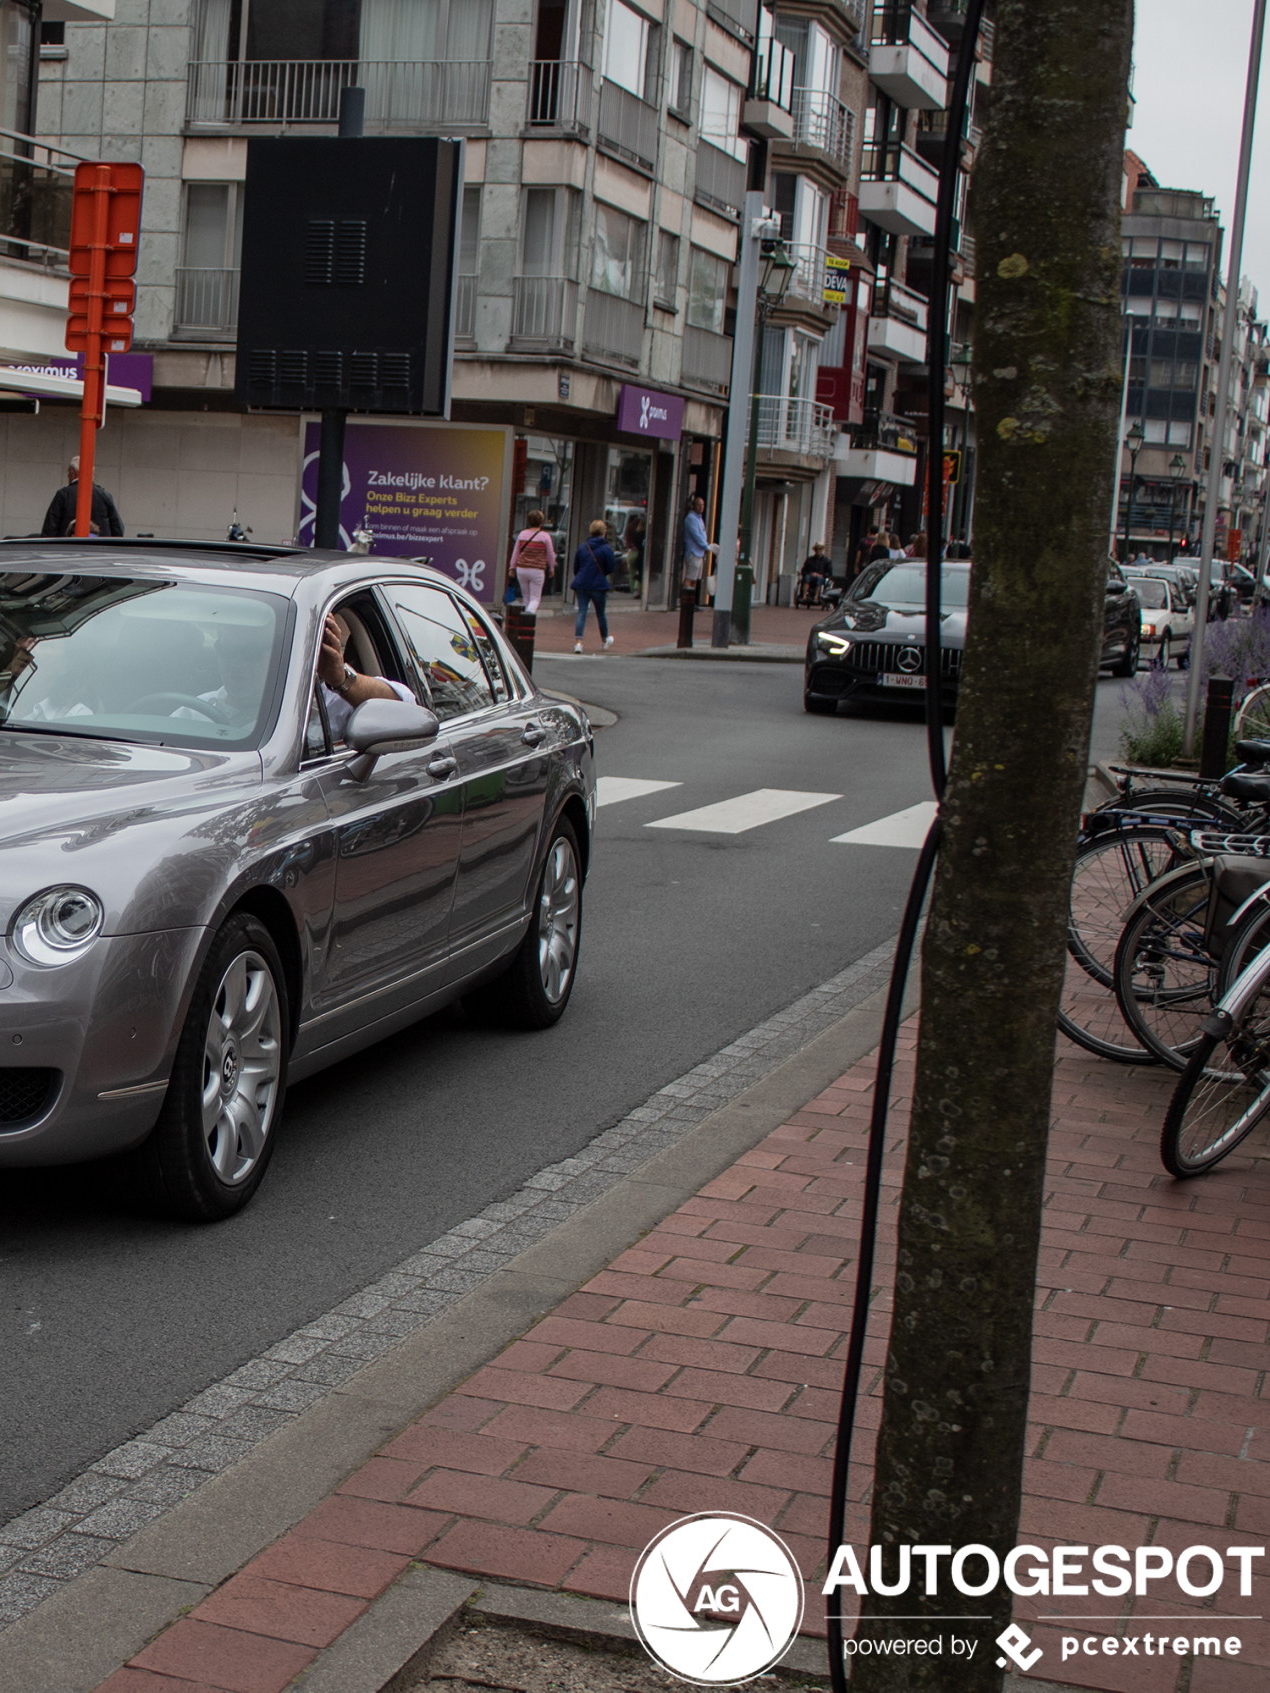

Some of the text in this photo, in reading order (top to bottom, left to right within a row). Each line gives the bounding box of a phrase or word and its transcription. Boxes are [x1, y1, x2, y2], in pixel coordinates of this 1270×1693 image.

[824, 274, 847, 291] DEVA
[368, 470, 490, 491] Zakelijke klant?
[367, 491, 458, 506] Onze Bizz Experts
[366, 503, 479, 519] helpen u graag verder
[380, 523, 401, 531] binnen
[402, 524, 410, 532] of
[410, 525, 427, 533] maak
[441, 527, 468, 536] afspraak
[469, 529, 478, 537] op
